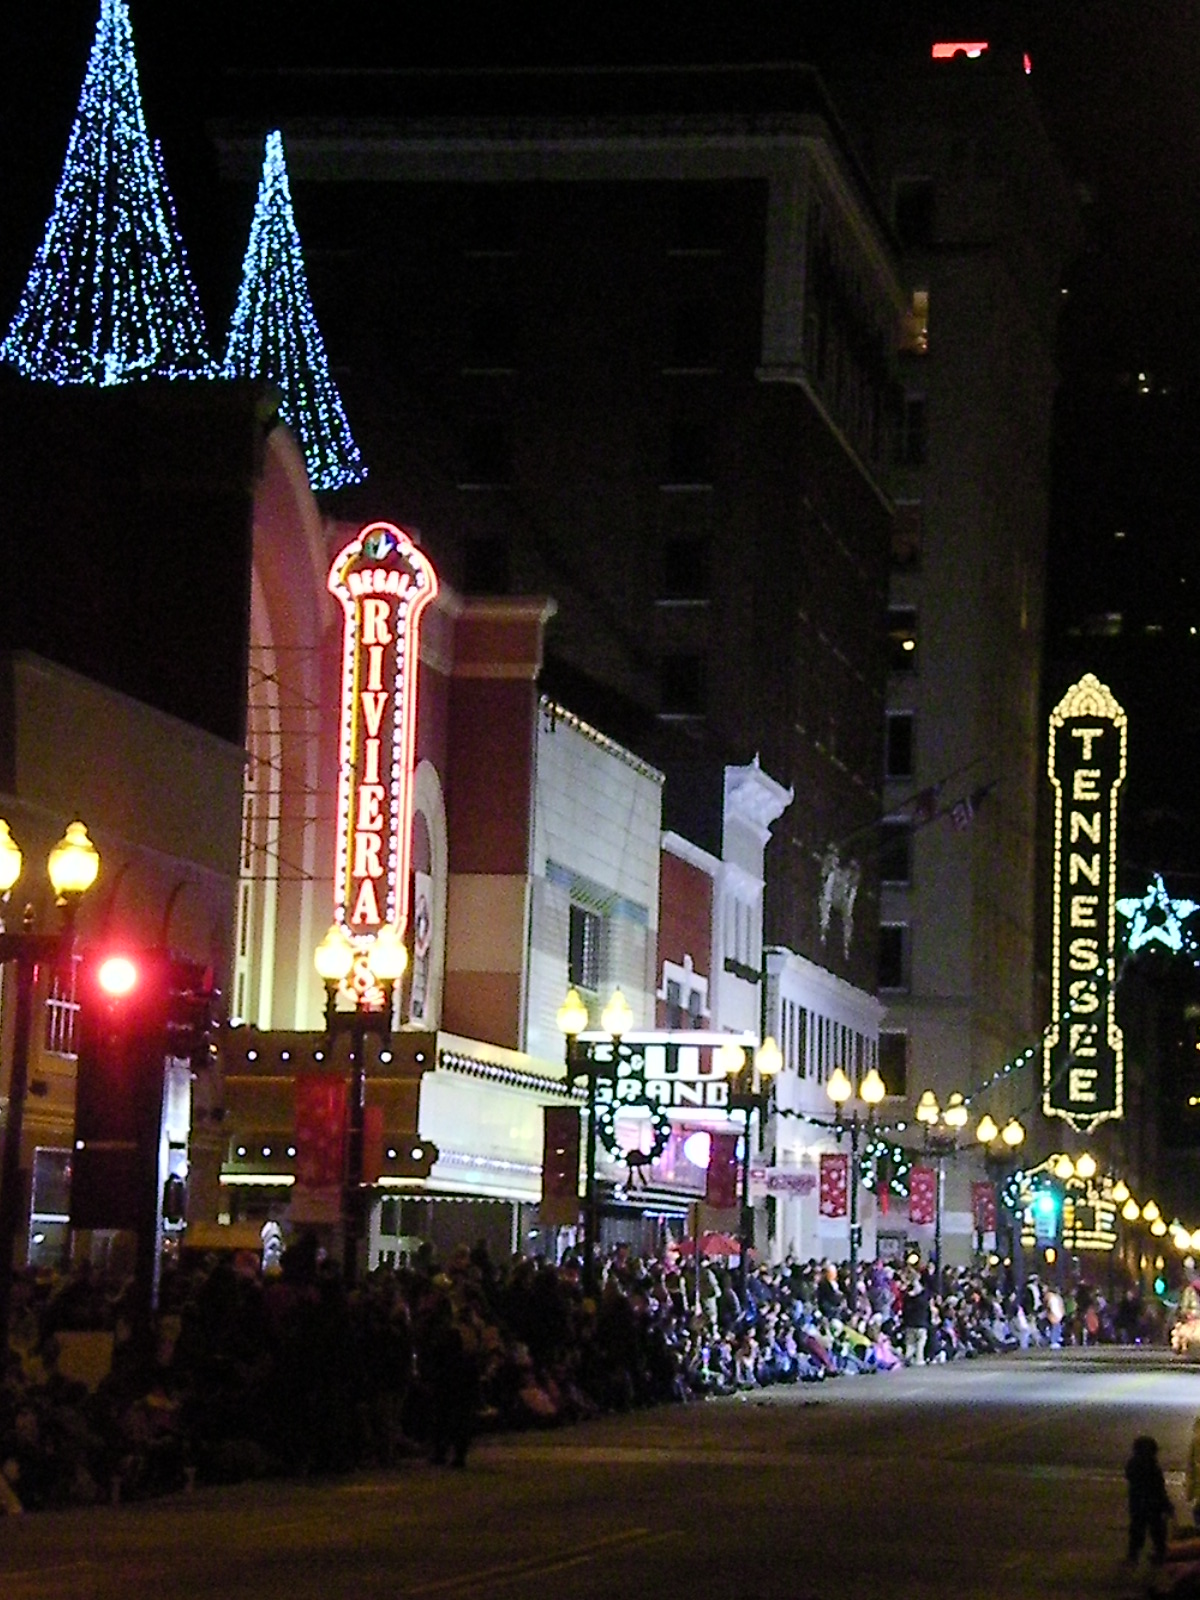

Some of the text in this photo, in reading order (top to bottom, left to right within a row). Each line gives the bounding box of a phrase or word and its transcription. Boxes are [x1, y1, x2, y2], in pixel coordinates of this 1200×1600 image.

[351, 598, 393, 925] RIVIERA
[1067, 727, 1104, 1102] TENNESSEE
[594, 1077, 729, 1107] GRAND
